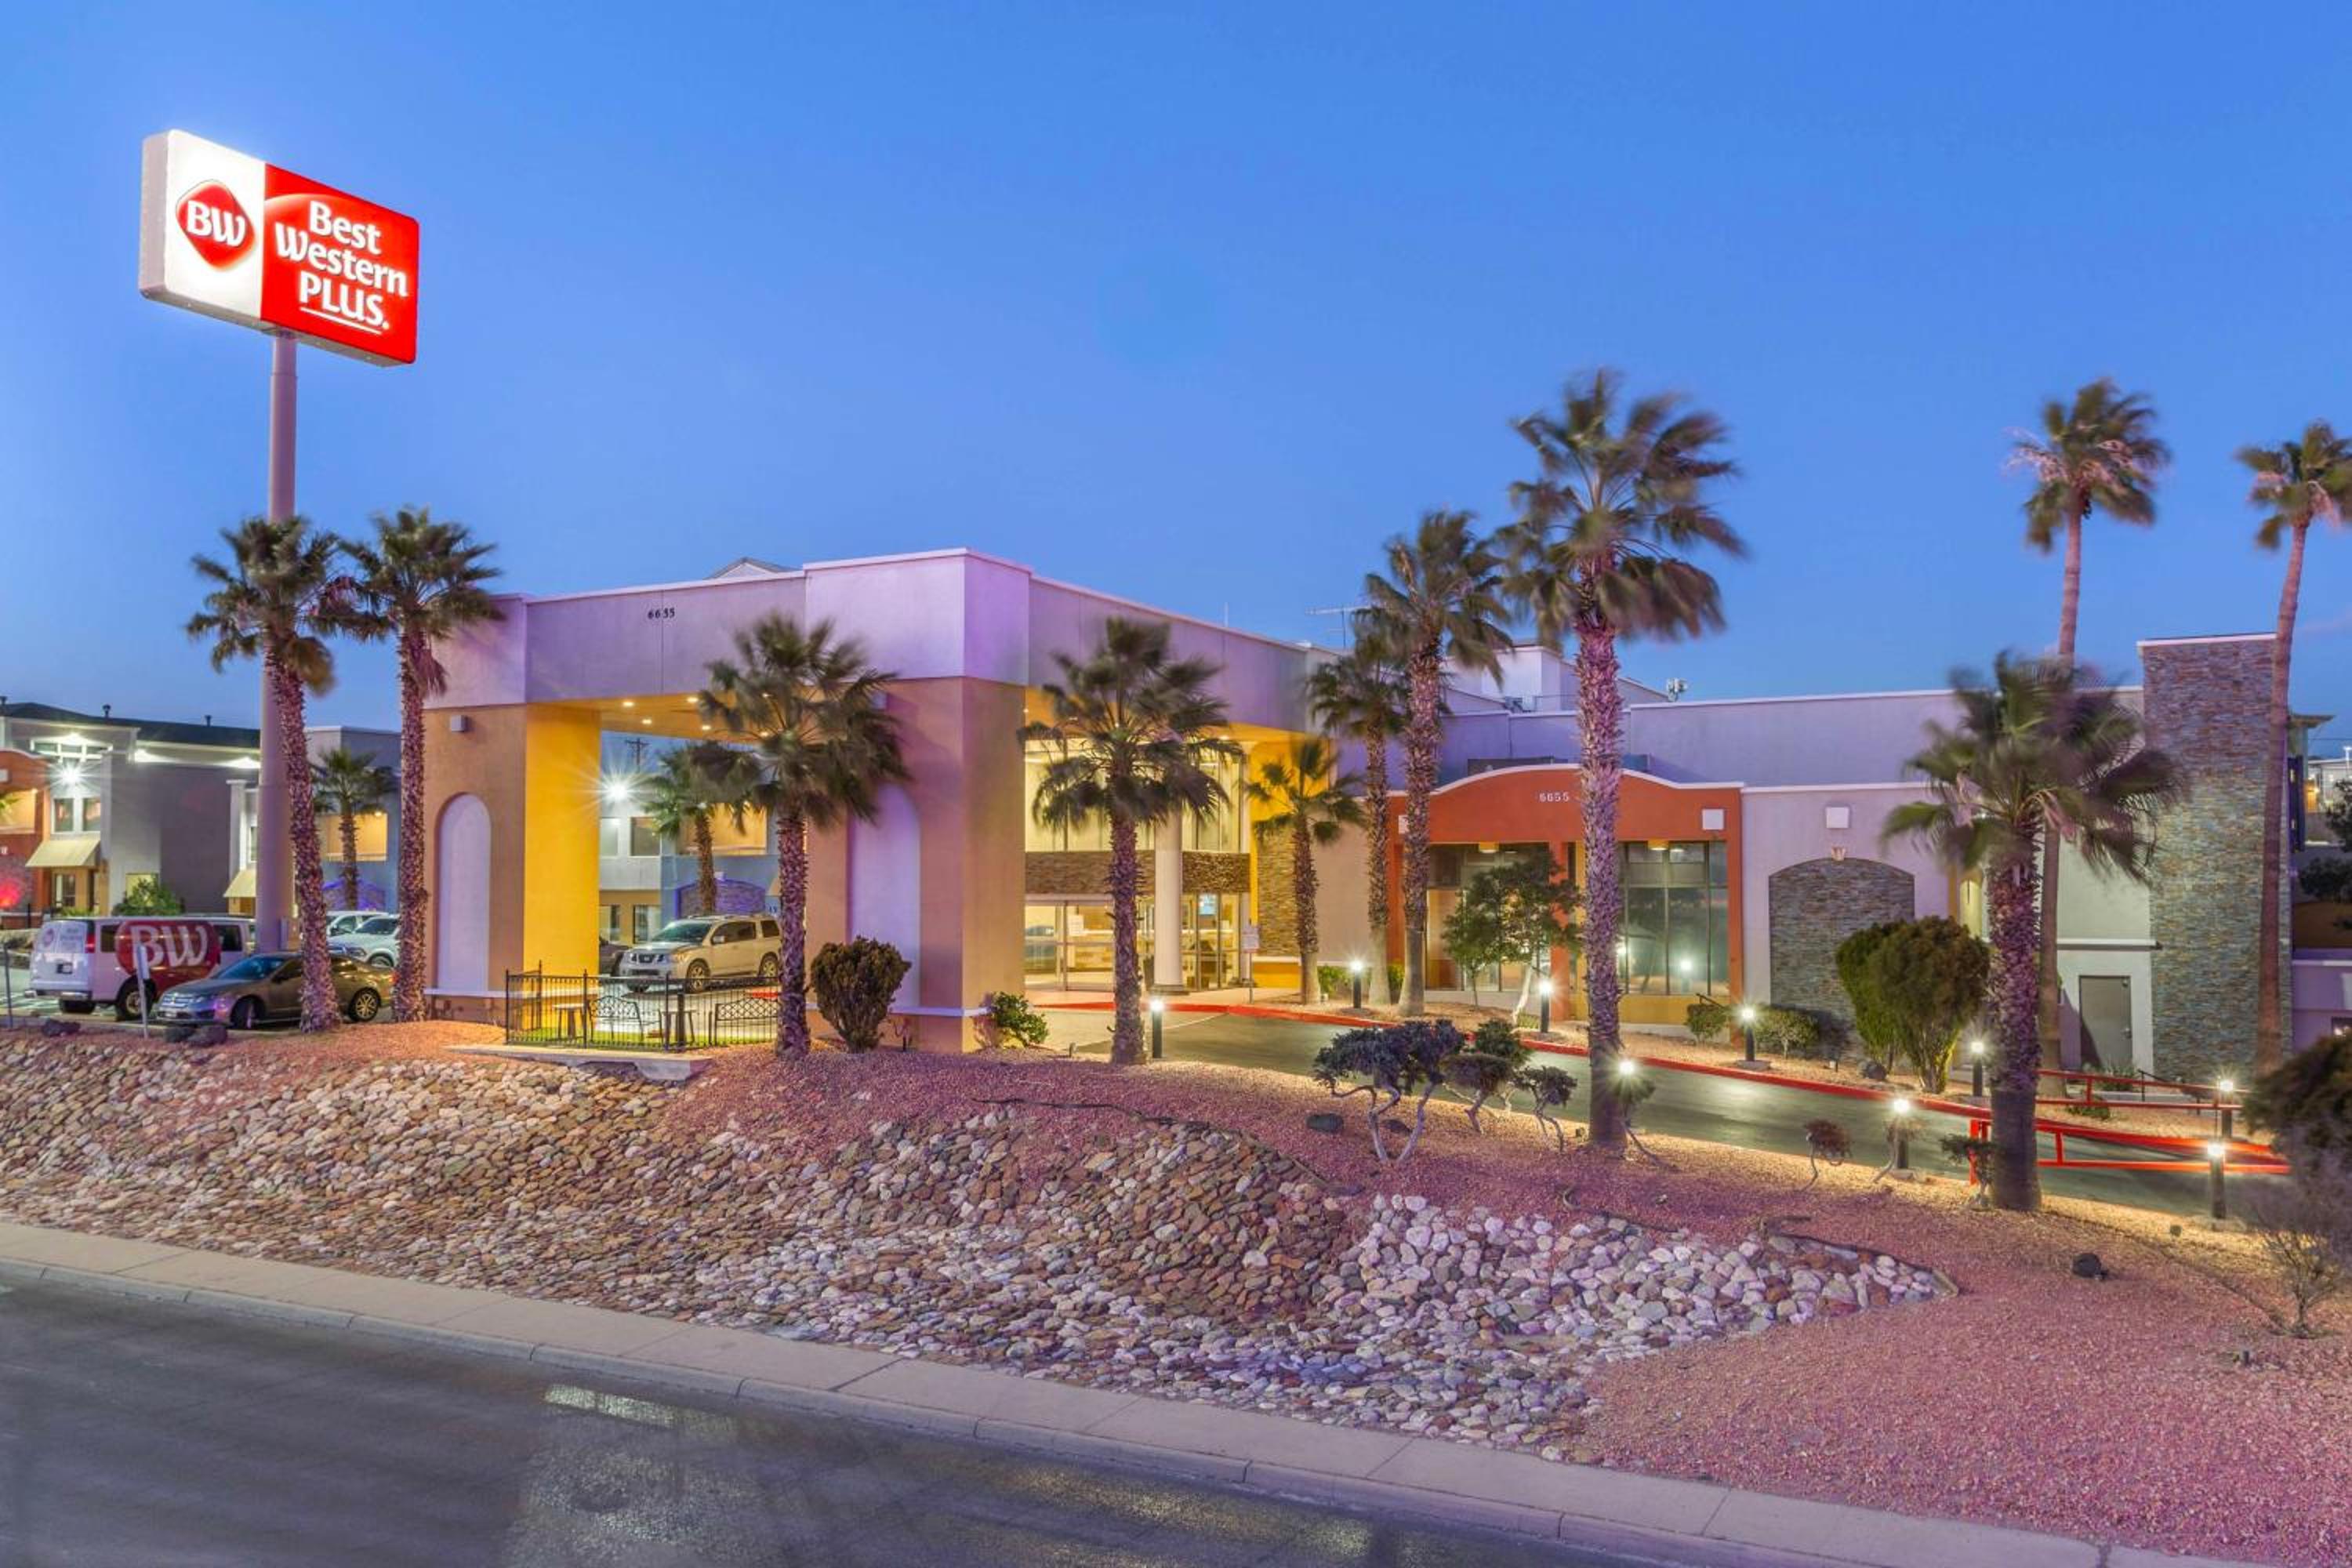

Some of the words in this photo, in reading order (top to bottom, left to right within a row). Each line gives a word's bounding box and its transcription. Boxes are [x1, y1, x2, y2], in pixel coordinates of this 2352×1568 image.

[187, 200, 245, 247] BW
[309, 201, 381, 255] Best
[275, 223, 408, 297] Western
[131, 925, 207, 967] BW
